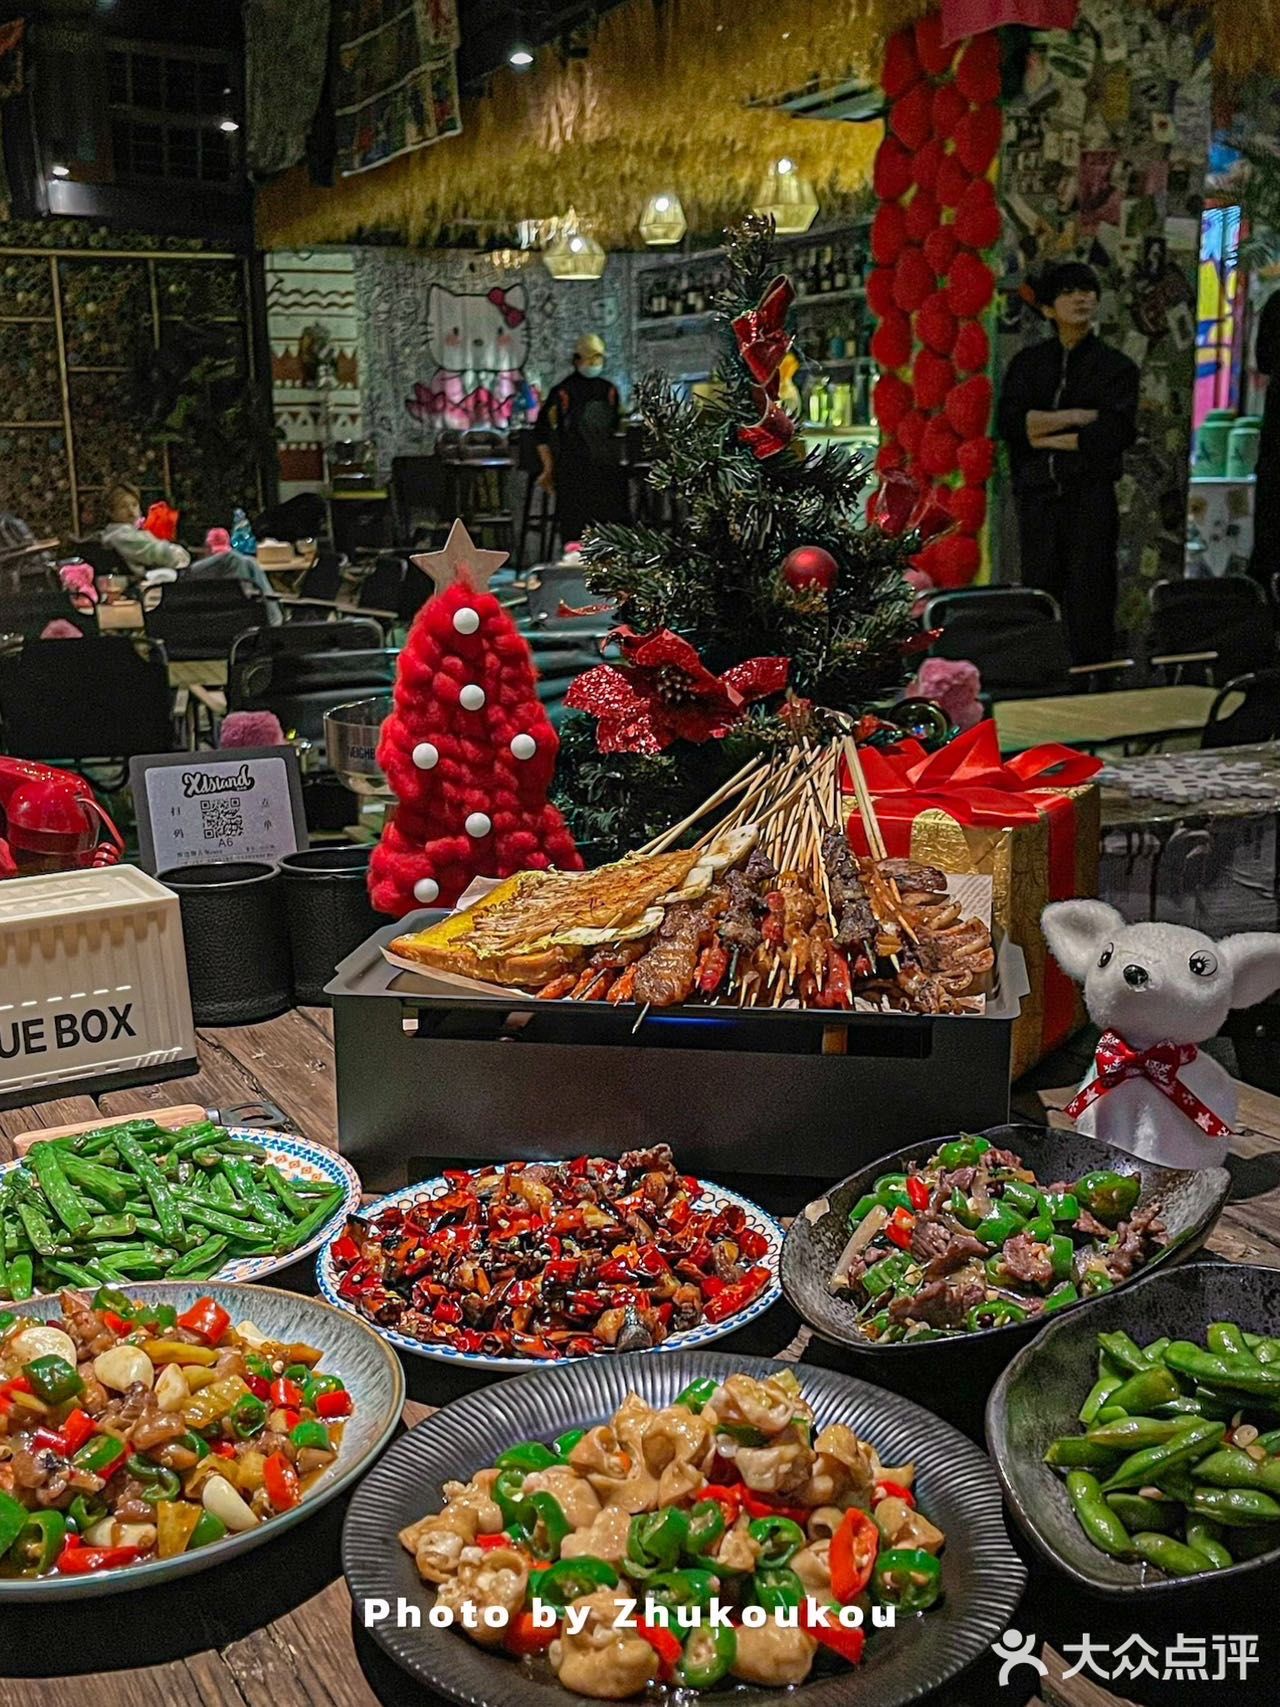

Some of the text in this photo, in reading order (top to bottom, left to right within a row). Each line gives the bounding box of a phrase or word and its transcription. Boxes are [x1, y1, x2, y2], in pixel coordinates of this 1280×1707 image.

[218, 838, 234, 848] A6
[0, 1003, 137, 1059] UE BOX
